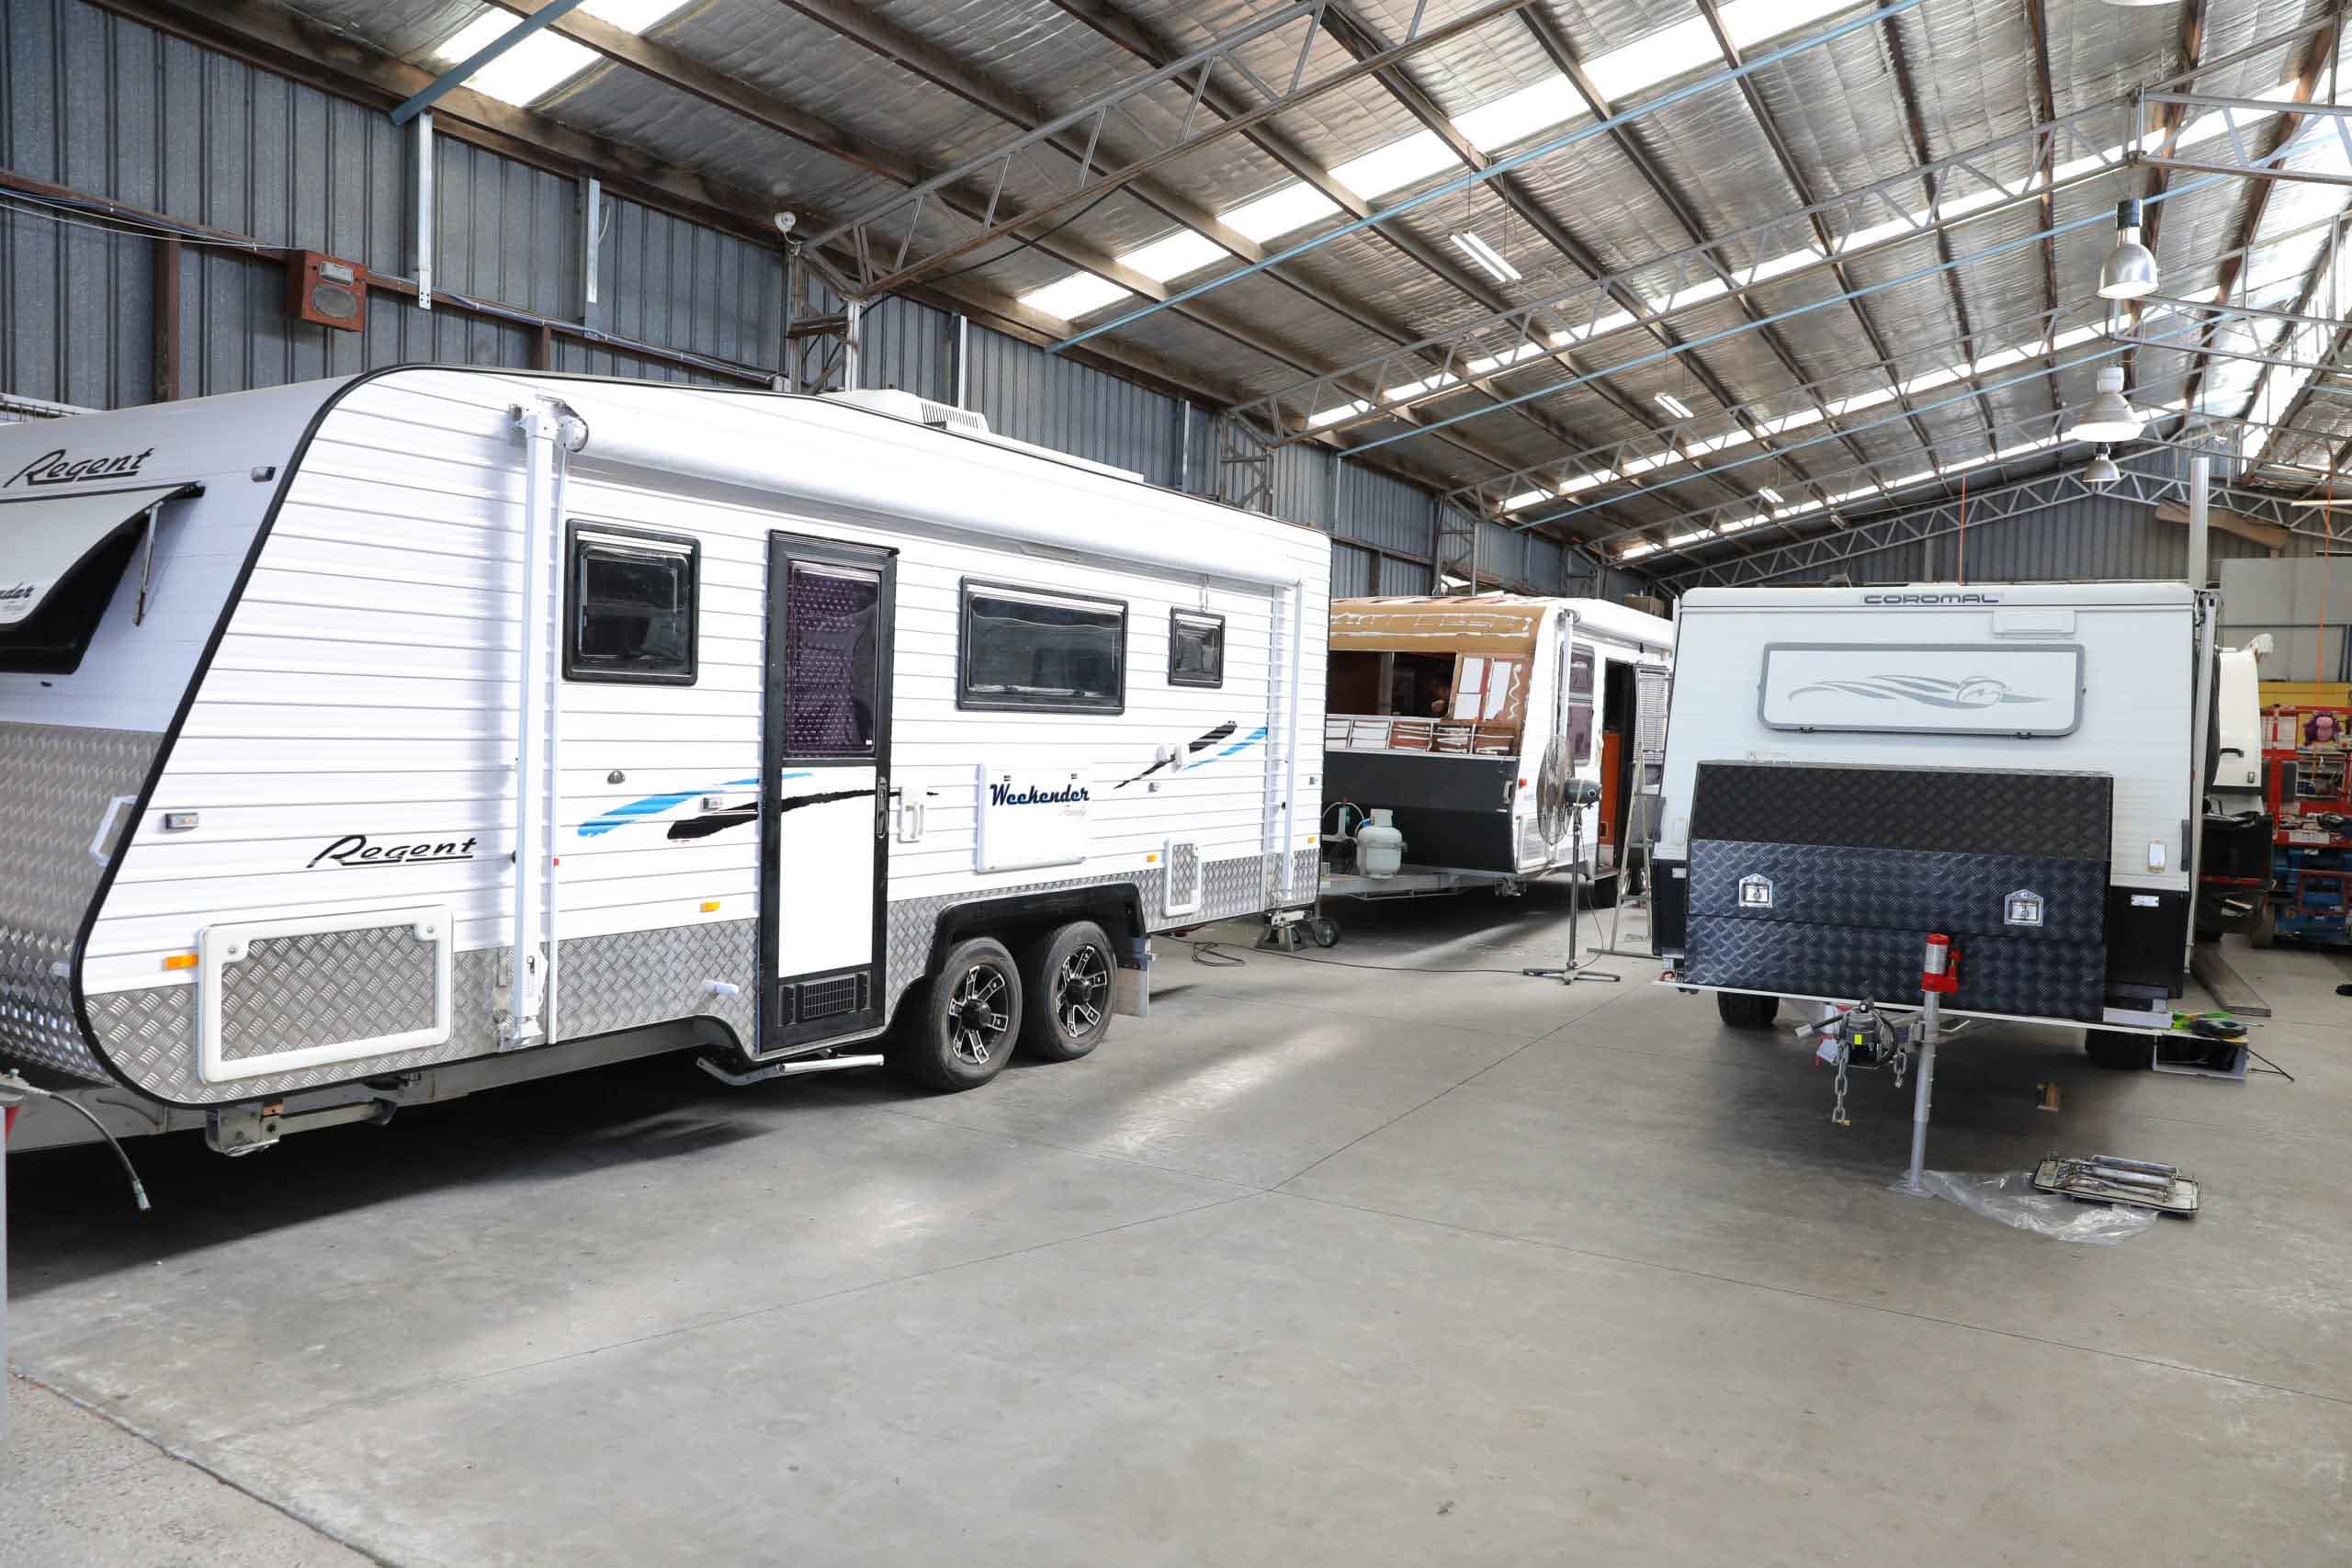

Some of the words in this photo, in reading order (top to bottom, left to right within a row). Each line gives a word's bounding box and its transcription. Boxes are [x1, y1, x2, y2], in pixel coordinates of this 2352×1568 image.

[3, 448, 154, 488] Regent
[1864, 593, 1999, 604] COROMAL
[989, 783, 1090, 807] Weekender
[307, 834, 477, 868] Regent
